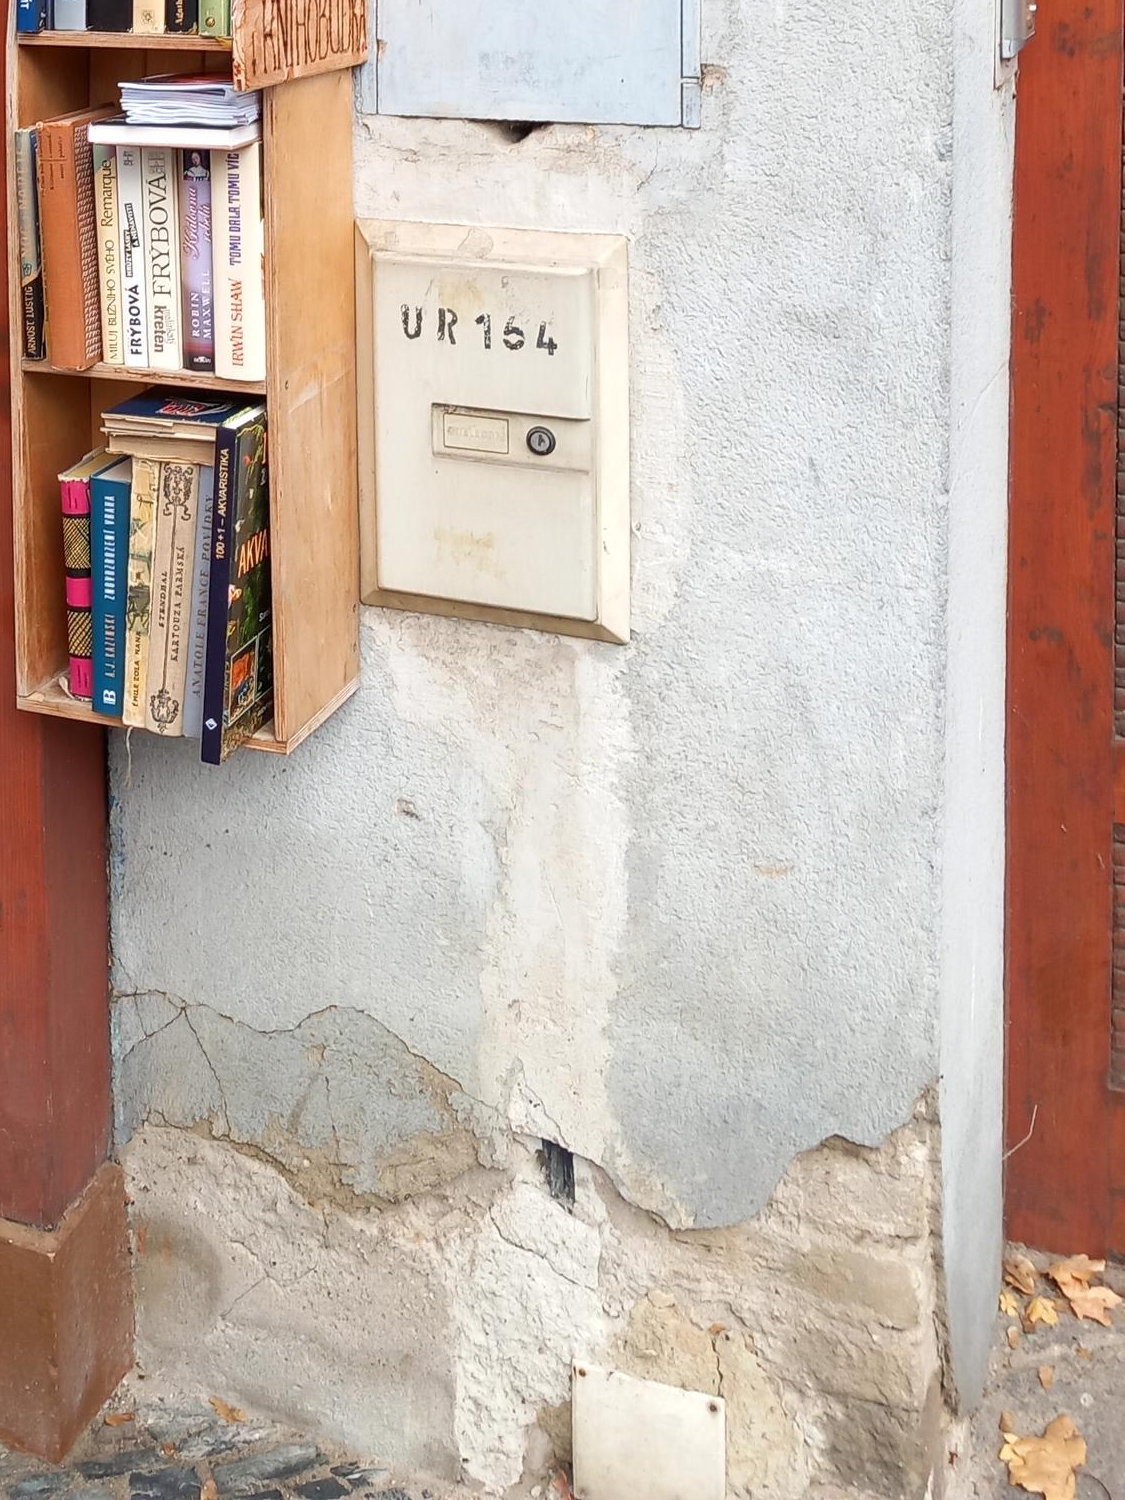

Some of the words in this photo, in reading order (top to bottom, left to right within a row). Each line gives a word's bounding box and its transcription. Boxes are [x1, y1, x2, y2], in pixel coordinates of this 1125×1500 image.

[100, 159, 114, 228] Remarque
[228, 172, 240, 204] TOMU
[104, 239, 115, 274] SVÉHO
[146, 172, 172, 299] FRÝBOVÁ
[229, 235, 242, 266] TOMU
[25, 286, 35, 319] LUSTIG
[124, 284, 142, 355] FRÝBOVÁ
[191, 291, 201, 337] ROBIN
[201, 270, 212, 340] MAXWELL
[228, 277, 243, 322] SHAW
[107, 330, 119, 361] MILUJ
[231, 324, 244, 367] IRWIN
[216, 447, 230, 517] AKVARISTIKA
[102, 495, 116, 525] VRAHA
[172, 545, 185, 597] PARMSKÁ
[157, 570, 168, 629] STENDHAL
[196, 569, 209, 627] FRANCE
[103, 614, 116, 658] KAZINSKI
[133, 630, 142, 655] NANA
[169, 600, 182, 662] KARTOUZA
[133, 660, 141, 681] ZOLA
[191, 630, 206, 698] ANATOLE
